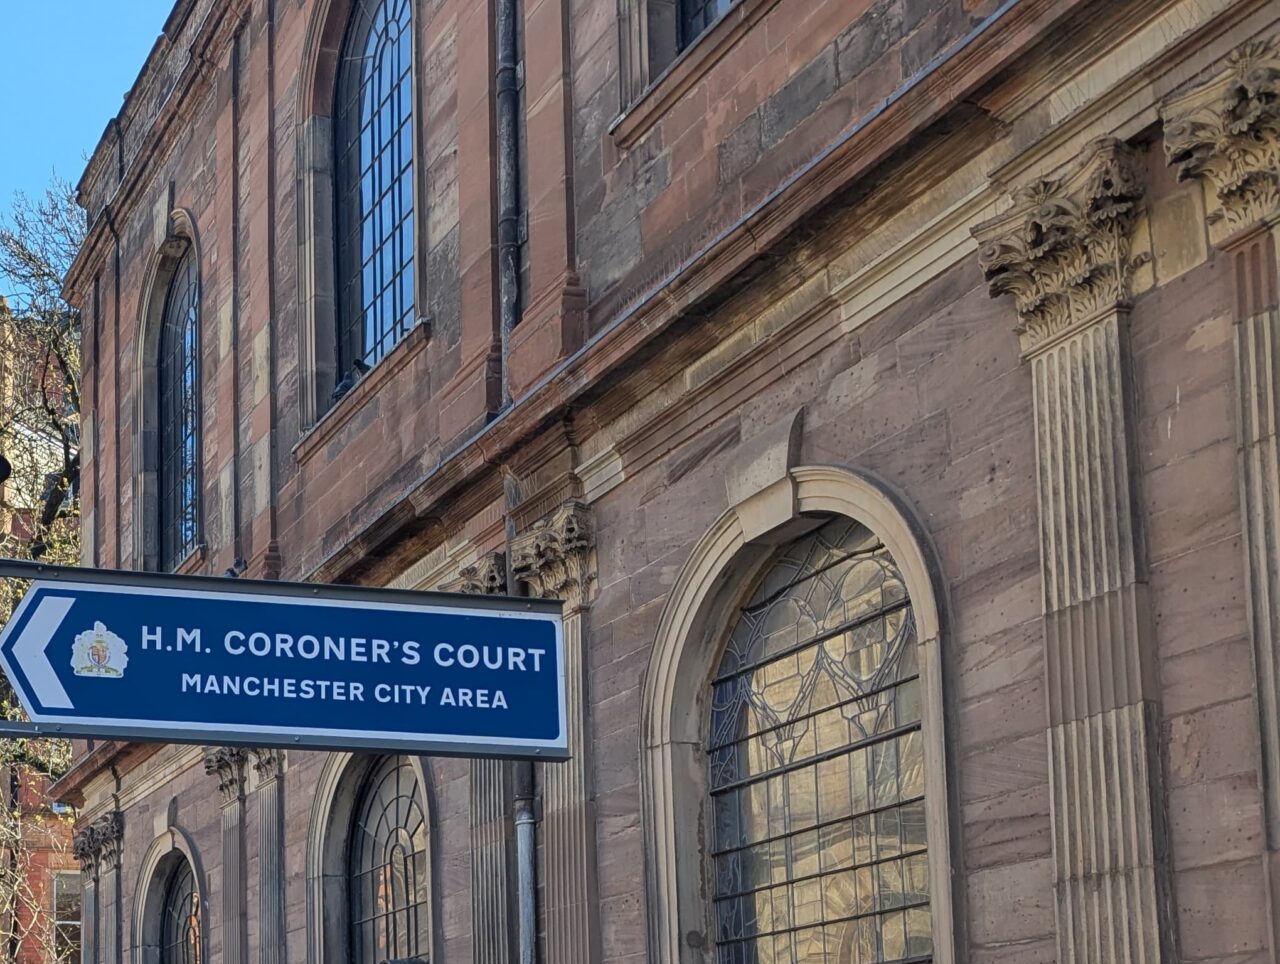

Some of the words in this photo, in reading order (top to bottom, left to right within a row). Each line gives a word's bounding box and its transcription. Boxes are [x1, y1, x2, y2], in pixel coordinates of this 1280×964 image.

[142, 625, 211, 654] H.M.
[224, 630, 420, 665] CORONER'S
[433, 642, 546, 672] COURT
[182, 673, 364, 701] MANCHESTER
[374, 683, 431, 705] CITY
[440, 687, 508, 709] AREA
